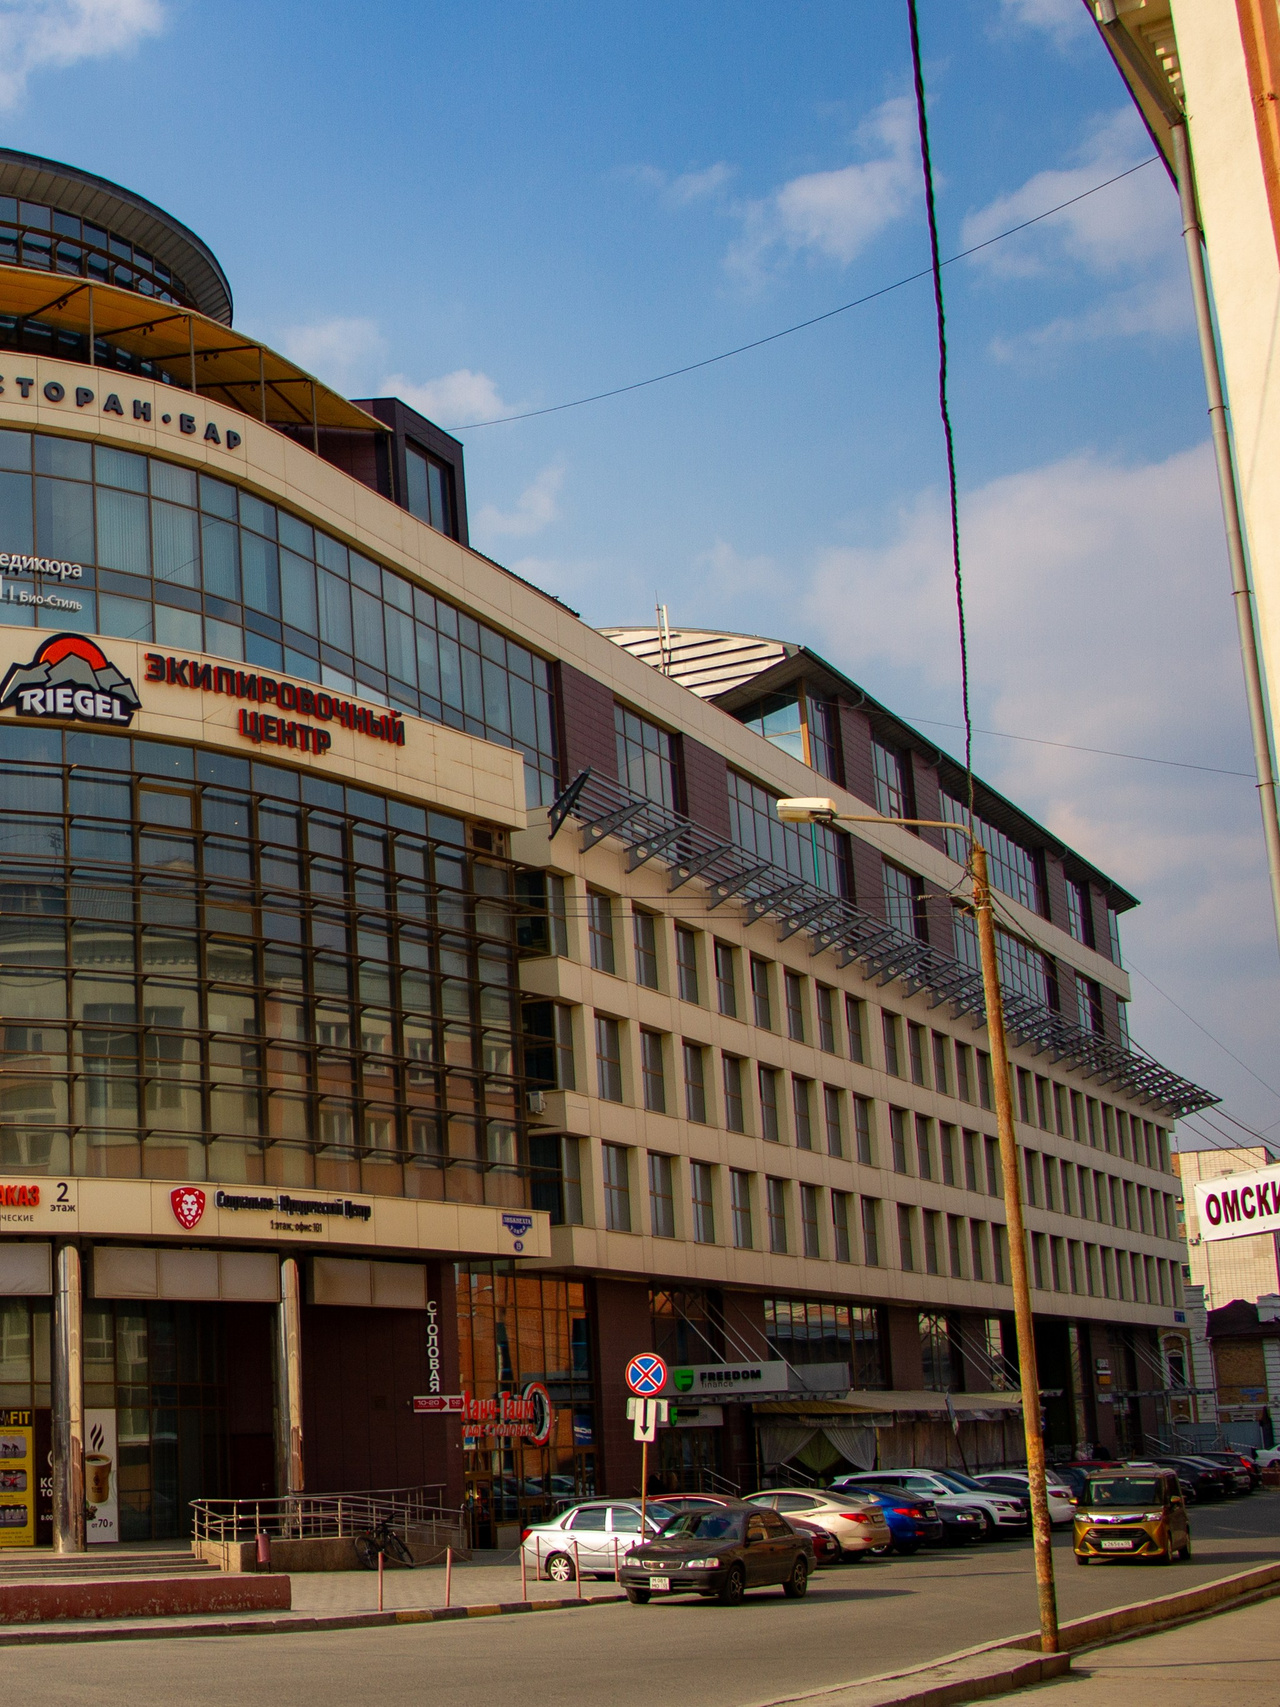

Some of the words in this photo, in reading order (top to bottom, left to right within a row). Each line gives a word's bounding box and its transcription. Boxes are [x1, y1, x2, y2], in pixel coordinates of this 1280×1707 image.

[180, 413, 243, 450] БАР
[18, 688, 130, 722] RIEGEL
[144, 652, 407, 747] ЭКИПИРОВОЧНЫЙ
[238, 708, 332, 756] ЦЕНТР
[56, 1181, 70, 1203] 2
[50, 1202, 77, 1212] этаж
[426, 1300, 441, 1393] СТОЛОВАЯ
[700, 1369, 762, 1382] FREEDOM
[701, 1380, 734, 1389] finance
[98, 1518, 108, 1529] 70
